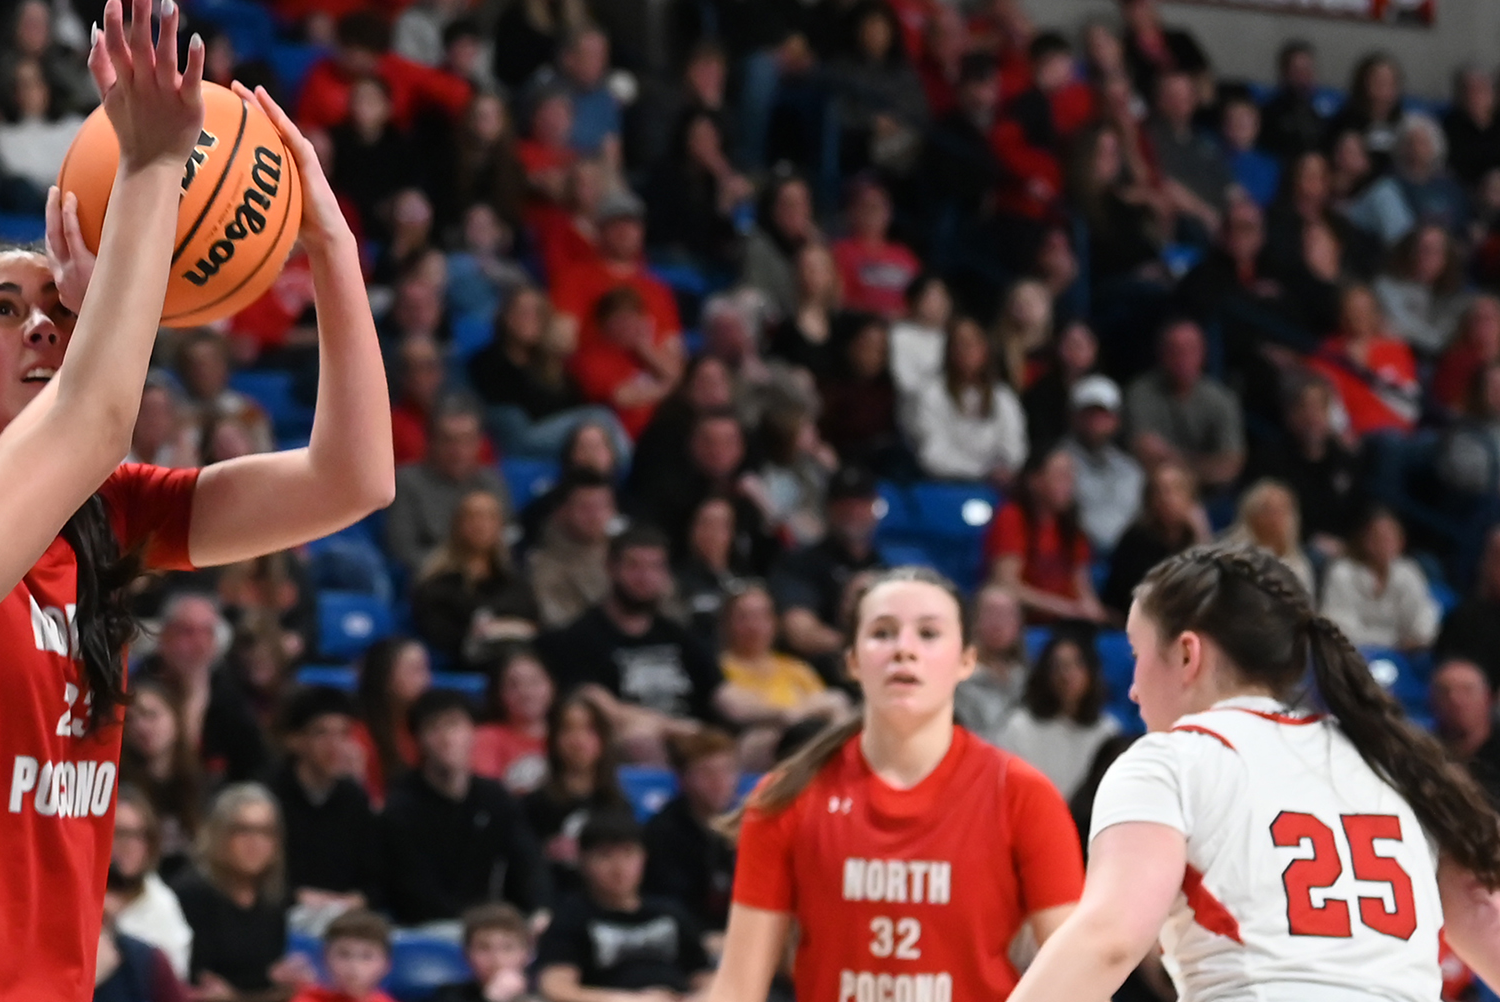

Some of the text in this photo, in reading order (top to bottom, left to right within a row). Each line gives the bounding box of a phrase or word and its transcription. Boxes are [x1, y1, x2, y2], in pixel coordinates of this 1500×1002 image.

[182, 146, 282, 287] Wilson
[842, 857, 952, 905] NORTH
[1268, 810, 1418, 942] 25
[868, 915, 922, 960] 32
